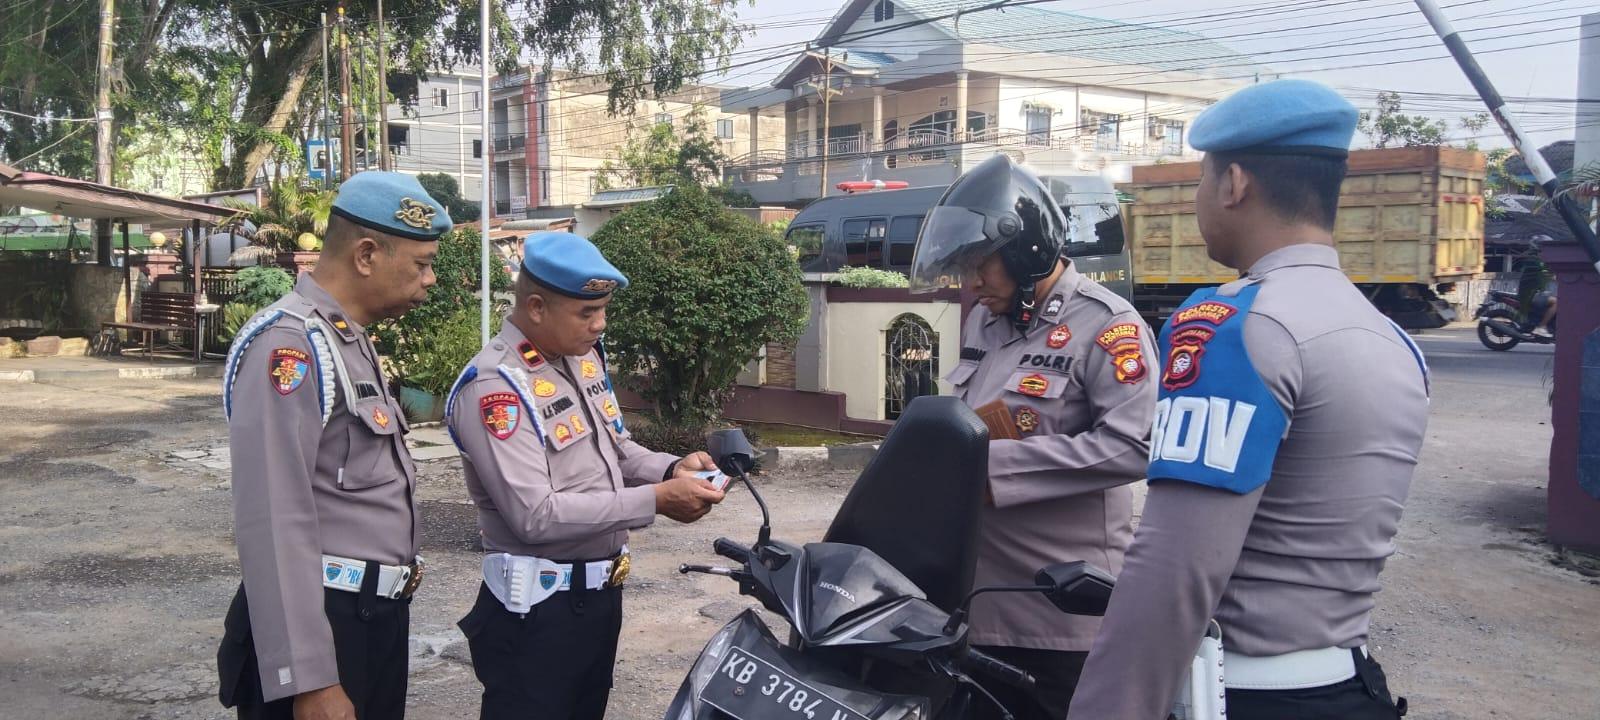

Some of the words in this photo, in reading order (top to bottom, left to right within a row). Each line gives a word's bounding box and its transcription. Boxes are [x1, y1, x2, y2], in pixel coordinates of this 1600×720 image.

[1099, 325, 1136, 343] POLRESTA
[277, 349, 306, 360] PROPAM
[1019, 354, 1073, 372] POLRI
[483, 394, 516, 403] PROPAM
[819, 581, 856, 603] HONDA
[722, 653, 757, 684] KB
[761, 674, 823, 719] 3784
